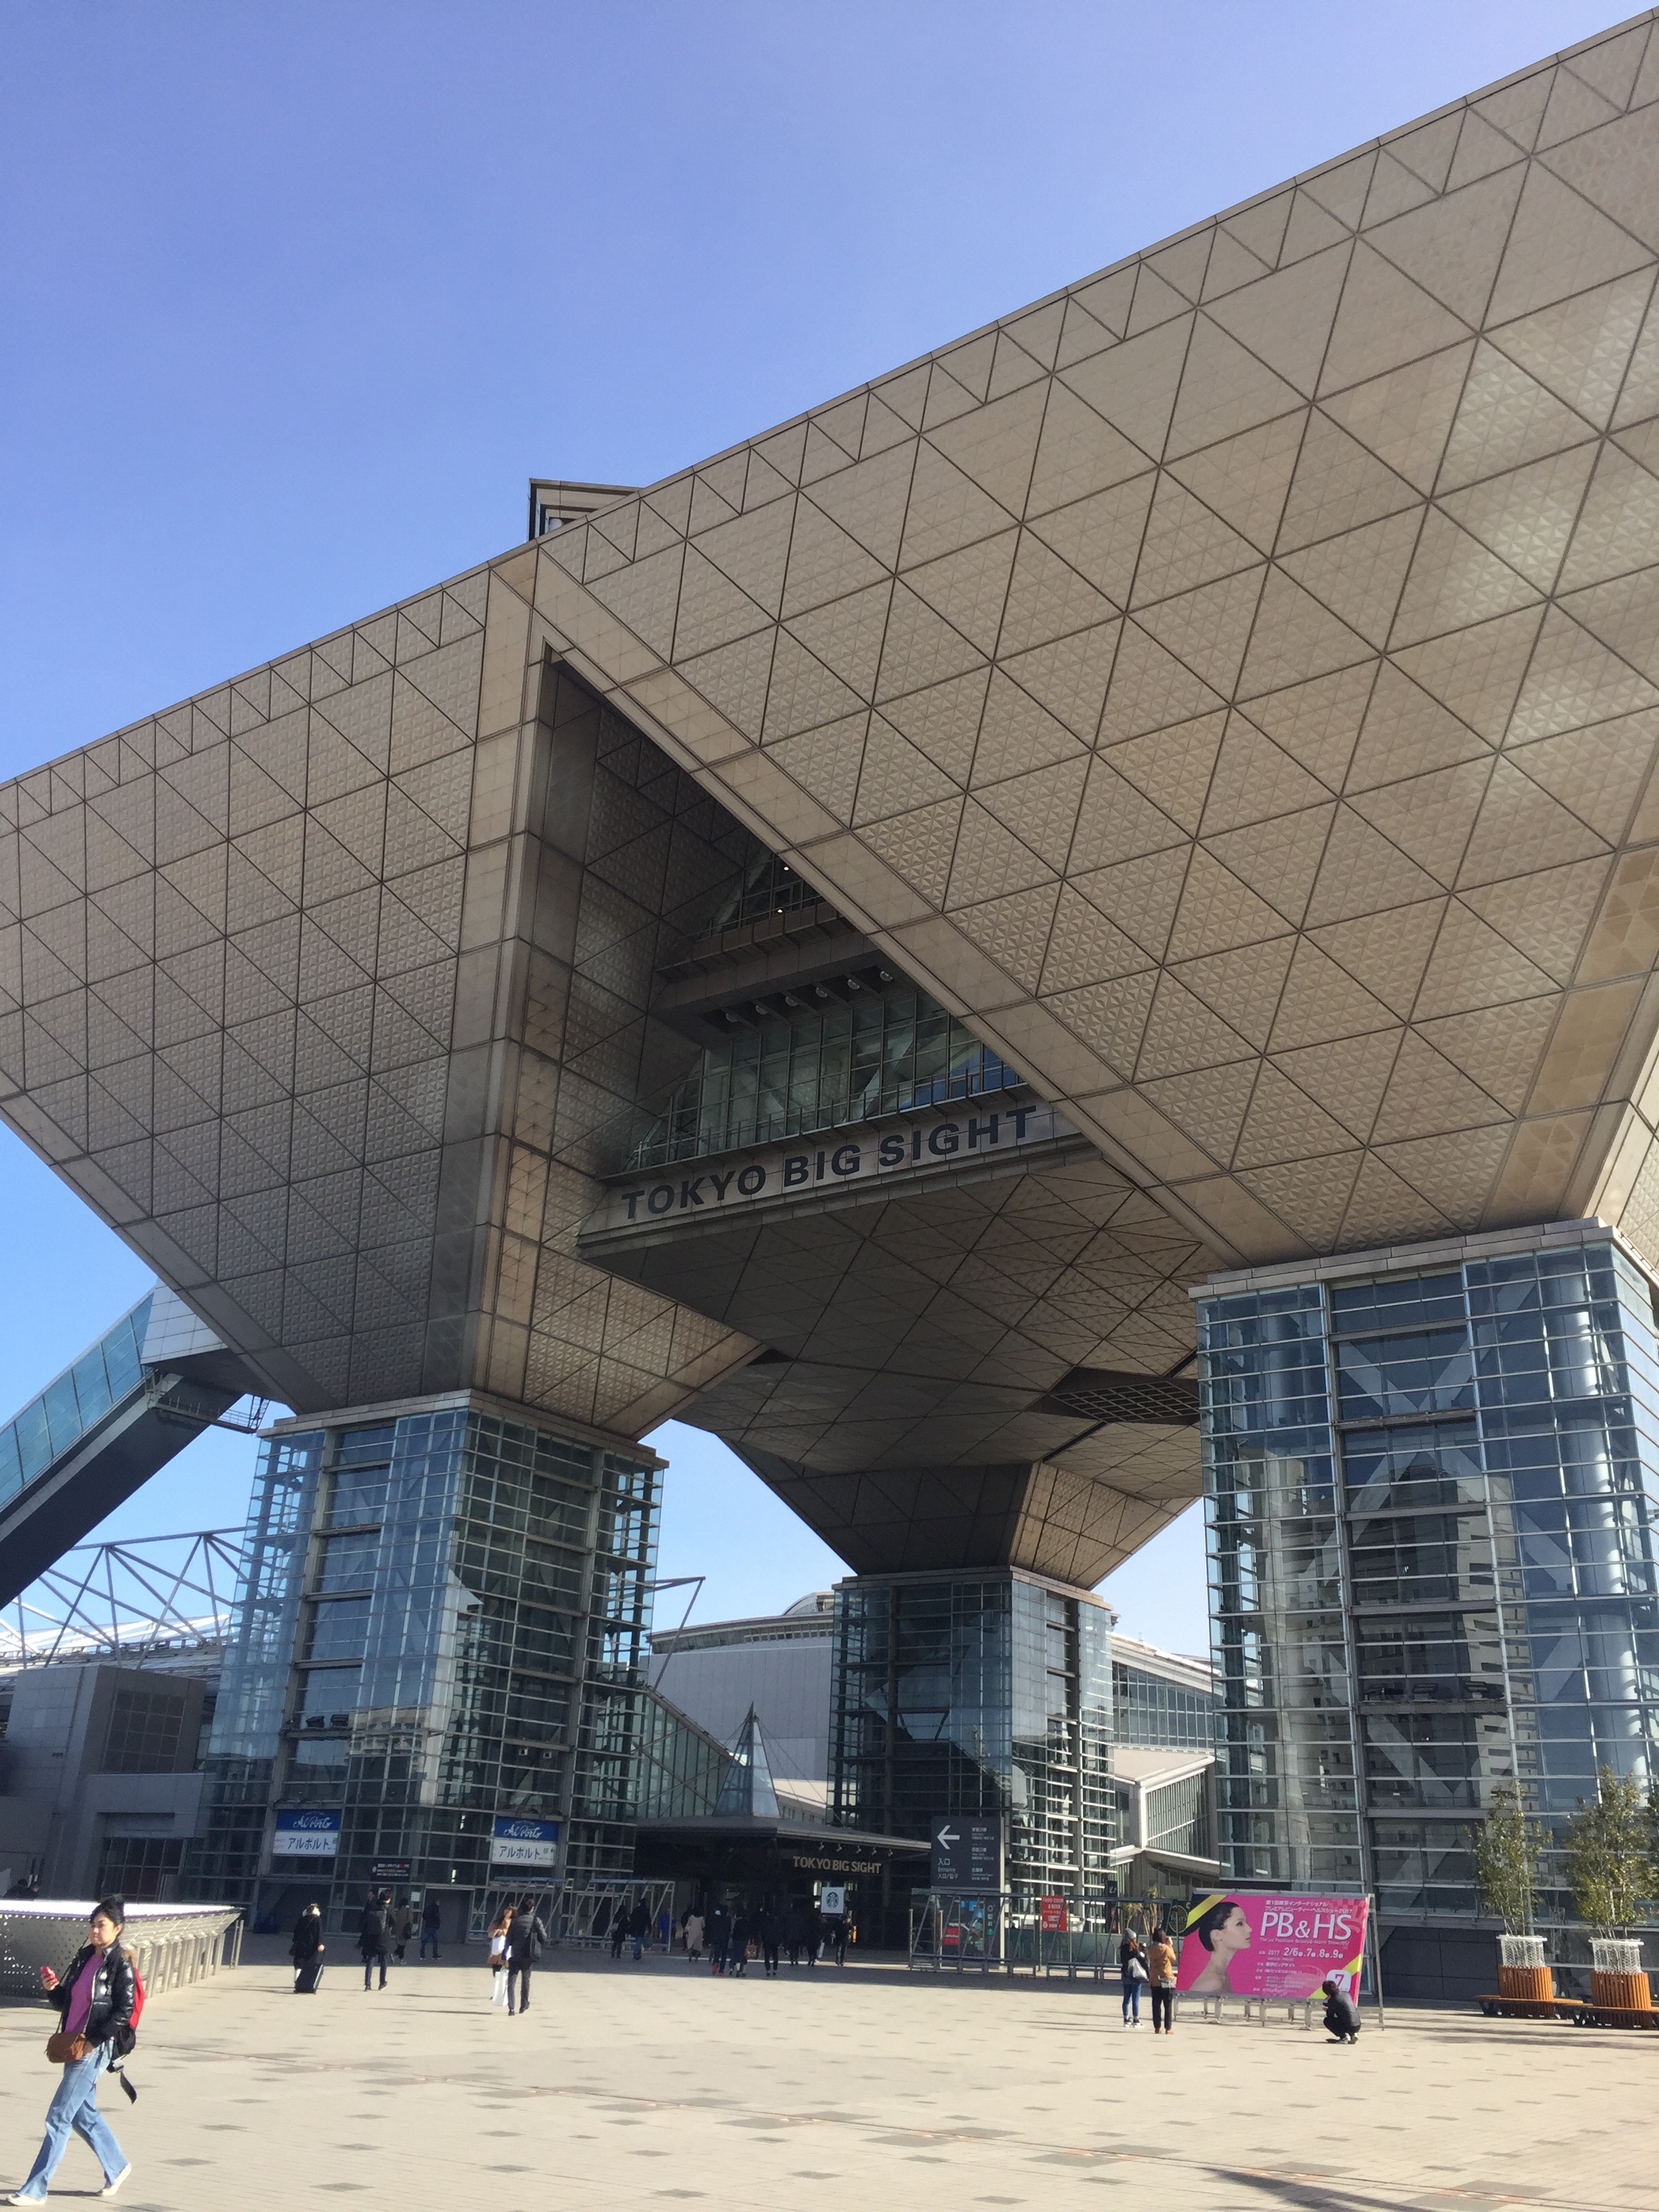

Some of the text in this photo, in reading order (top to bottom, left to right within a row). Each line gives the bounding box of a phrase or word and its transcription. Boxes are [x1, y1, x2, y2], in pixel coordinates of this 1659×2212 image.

[621, 1105, 1037, 1220] TOKYO BIG SIGHT
[293, 1816, 333, 1829] Al Porto
[504, 1824, 543, 1839] Al Porto
[793, 1856, 882, 1874] TOKYO BIG SIGHT
[937, 1858, 951, 1866] 入口
[1334, 1973, 1345, 1988] 7
